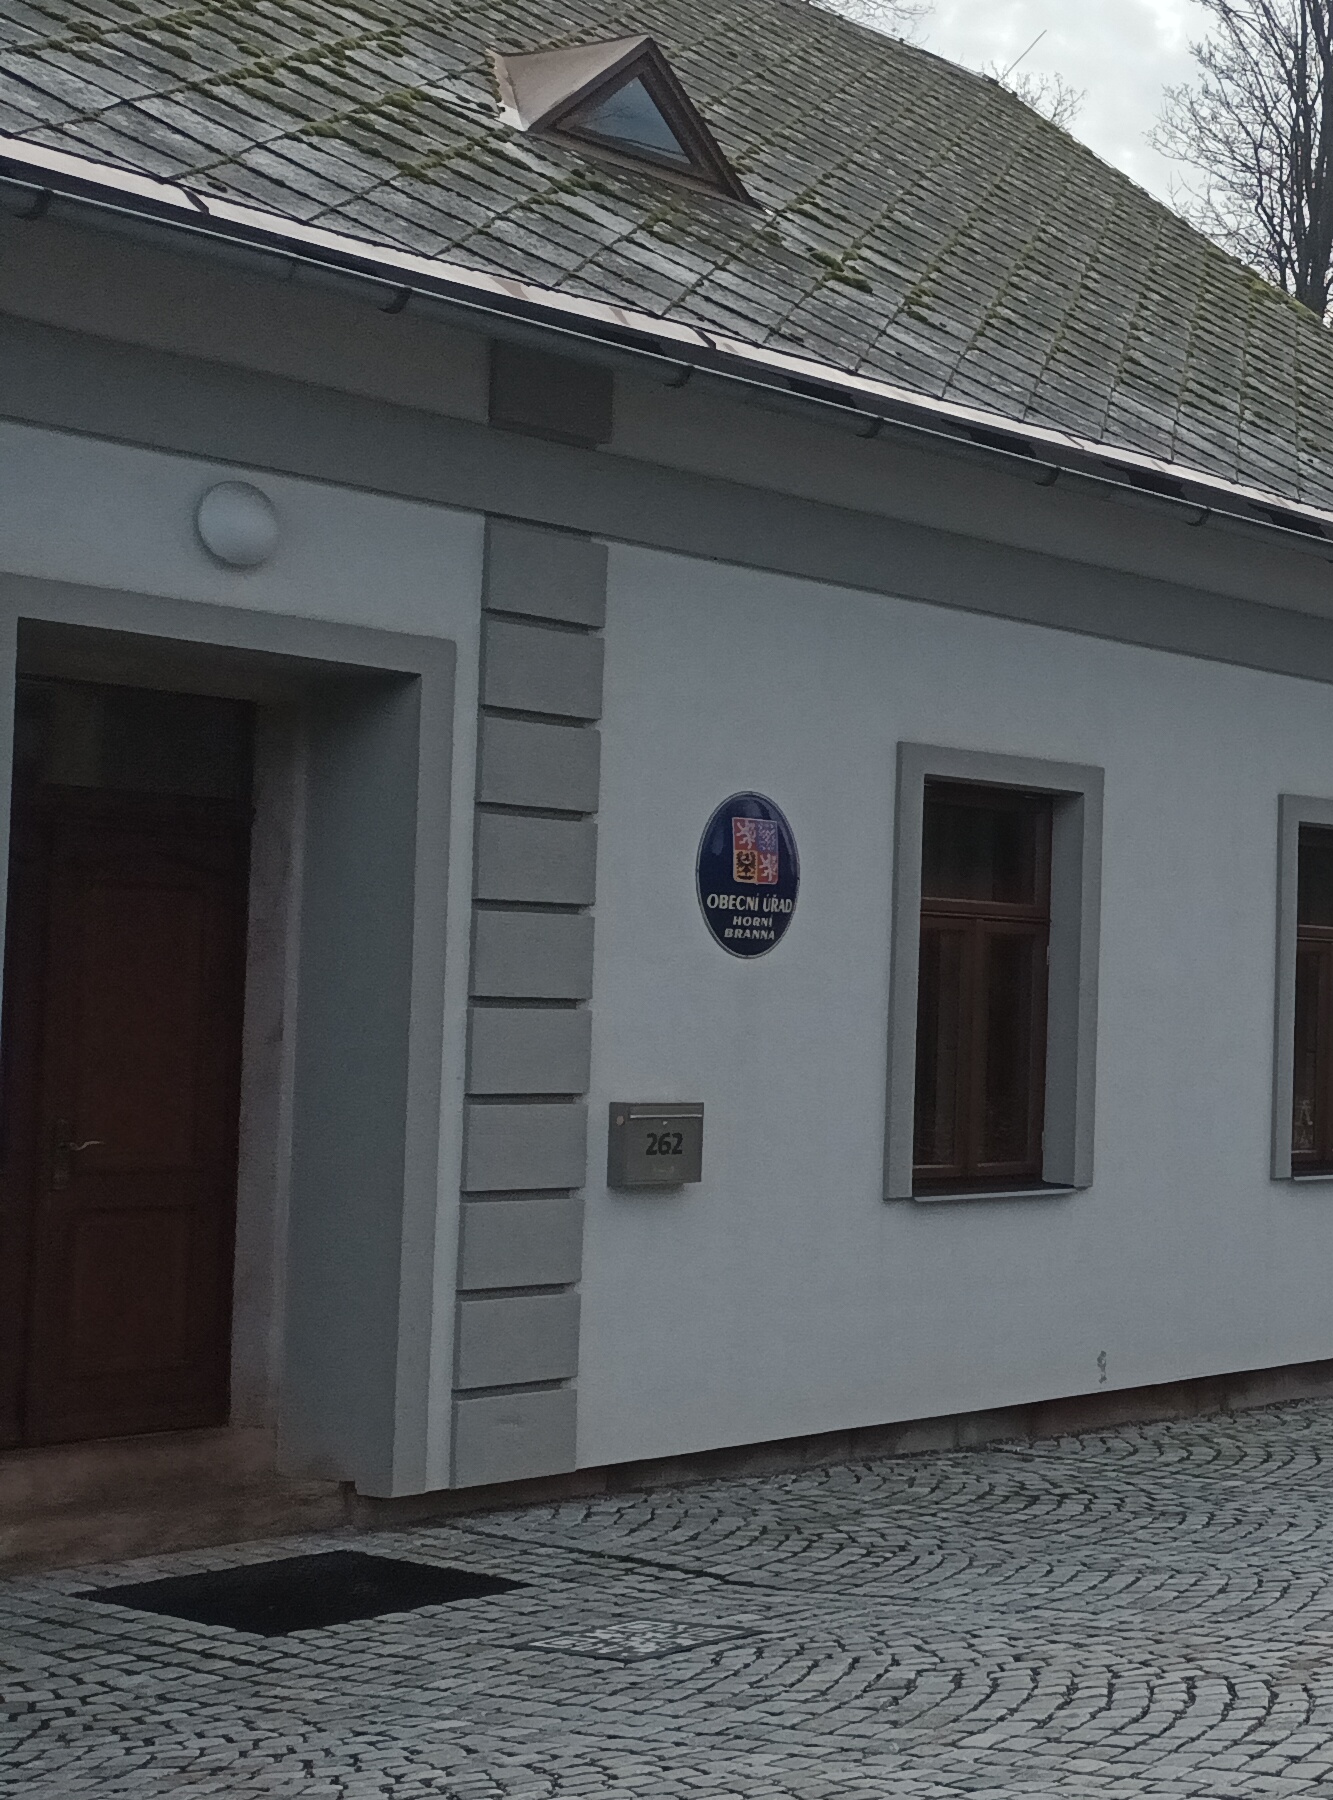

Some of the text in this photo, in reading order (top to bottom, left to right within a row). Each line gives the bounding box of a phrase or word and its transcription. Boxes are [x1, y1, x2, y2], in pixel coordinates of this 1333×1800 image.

[707, 893, 792, 913] OBECNÍ ÚŘAD
[733, 914, 773, 927] HORNÍ
[645, 1132, 683, 1155] 262
